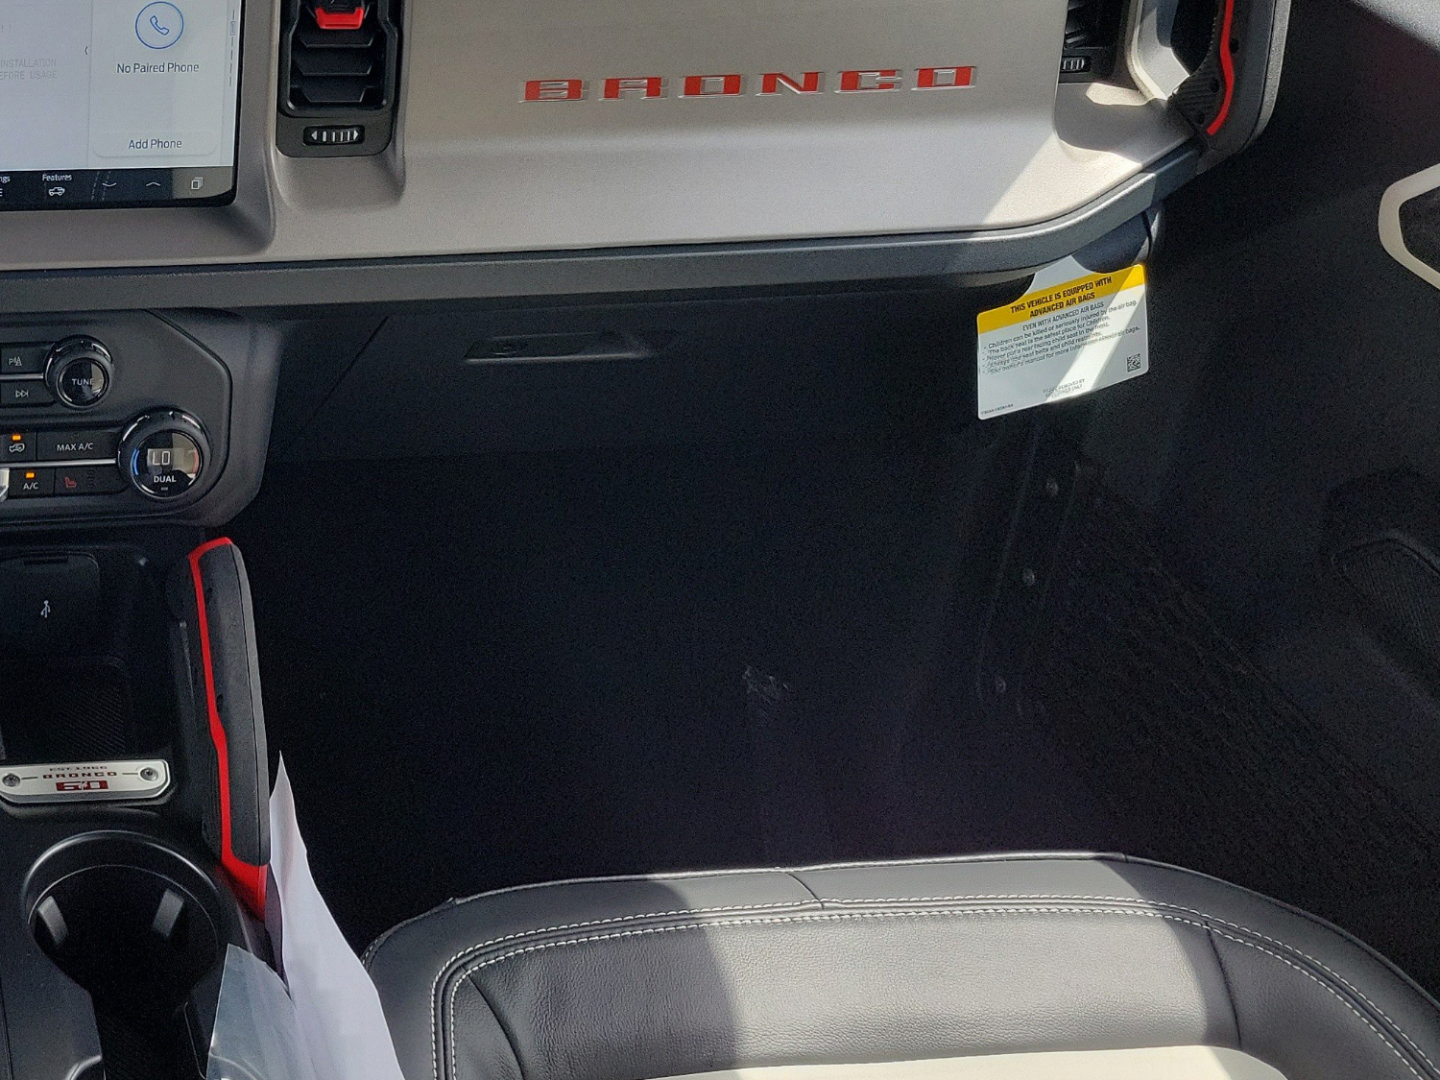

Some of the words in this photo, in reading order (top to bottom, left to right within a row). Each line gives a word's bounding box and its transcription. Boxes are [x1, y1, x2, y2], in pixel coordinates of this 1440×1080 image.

[117, 63, 131, 74] No
[133, 62, 165, 73] Paired
[167, 62, 199, 73] Phone
[519, 65, 976, 103] BRONCO
[128, 139, 148, 149] Add
[150, 138, 182, 149] Phone
[42, 174, 73, 182] Features
[1010, 303, 1026, 314] THIS
[1027, 295, 1053, 309] VEHICLE
[1055, 292, 1061, 300] IS
[1063, 283, 1093, 298] EQUIPPED
[1095, 276, 1112, 289] WITH
[1030, 301, 1064, 318] ADVANCED
[1065, 298, 1077, 309] AIR
[1078, 292, 1095, 305] BAGS
[71, 377, 94, 386] TUNE
[56, 444, 76, 452] MAX
[77, 442, 94, 451] A/C
[153, 475, 176, 484] DUAL
[23, 482, 39, 491] A/C
[42, 771, 117, 779] BRONCO
